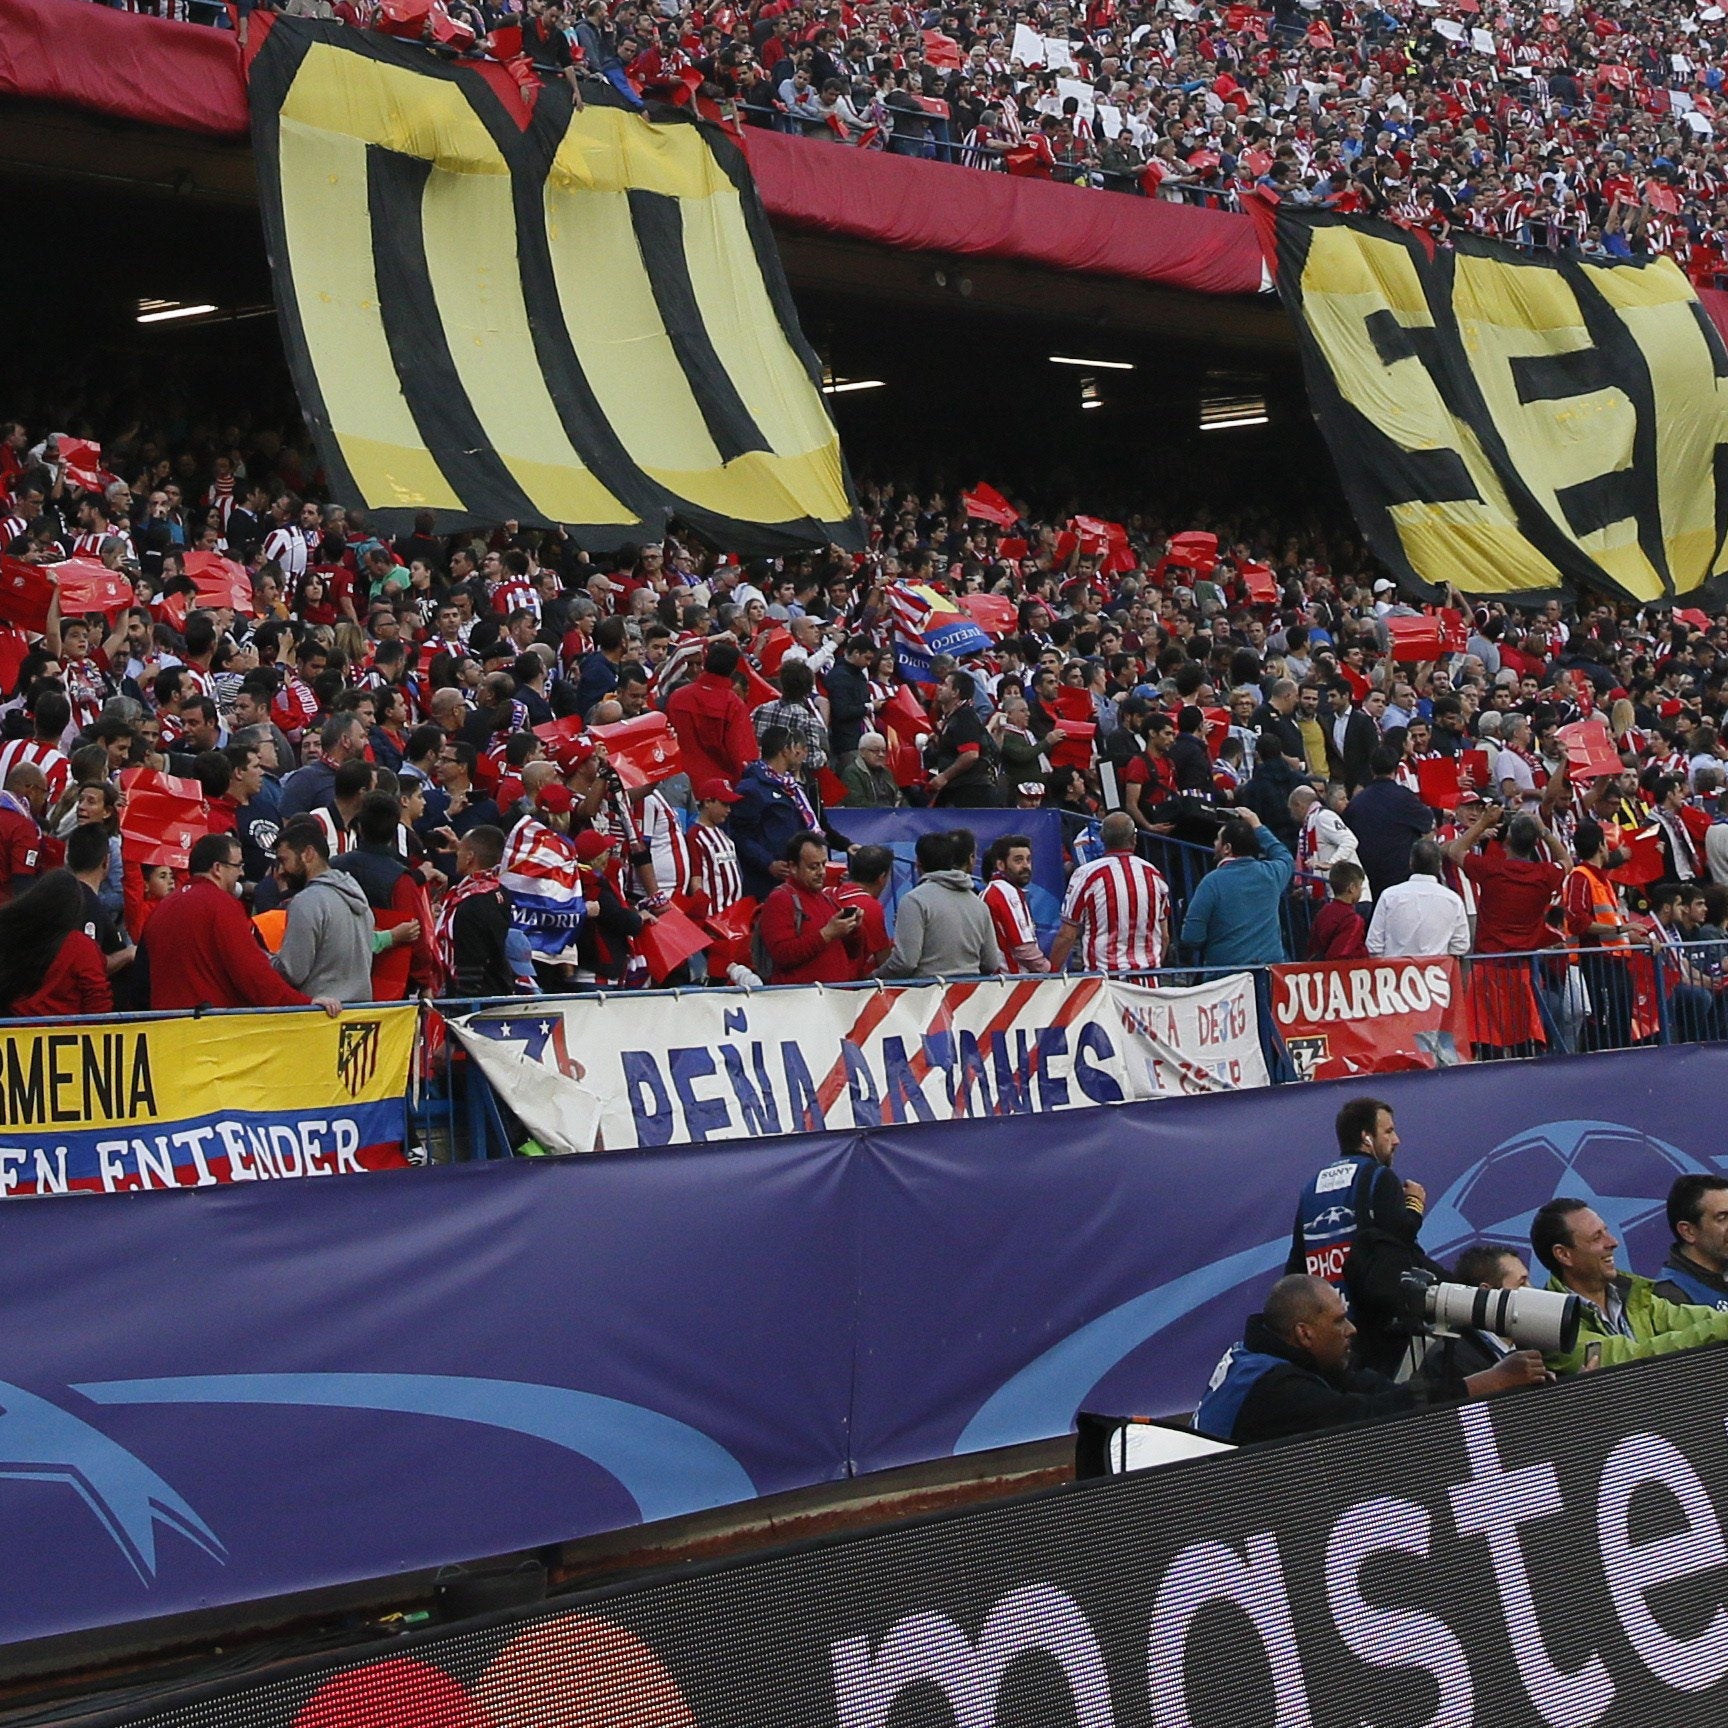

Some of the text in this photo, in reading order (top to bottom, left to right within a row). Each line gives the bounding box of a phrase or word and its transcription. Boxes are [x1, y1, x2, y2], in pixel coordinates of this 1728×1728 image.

[278, 41, 854, 525] NO
[1197, 993, 1246, 1047] DEJES
[1277, 965, 1453, 1025] JUARROS
[620, 1007, 826, 1149] PEÑA
[97, 1117, 369, 1192] ENTENDER
